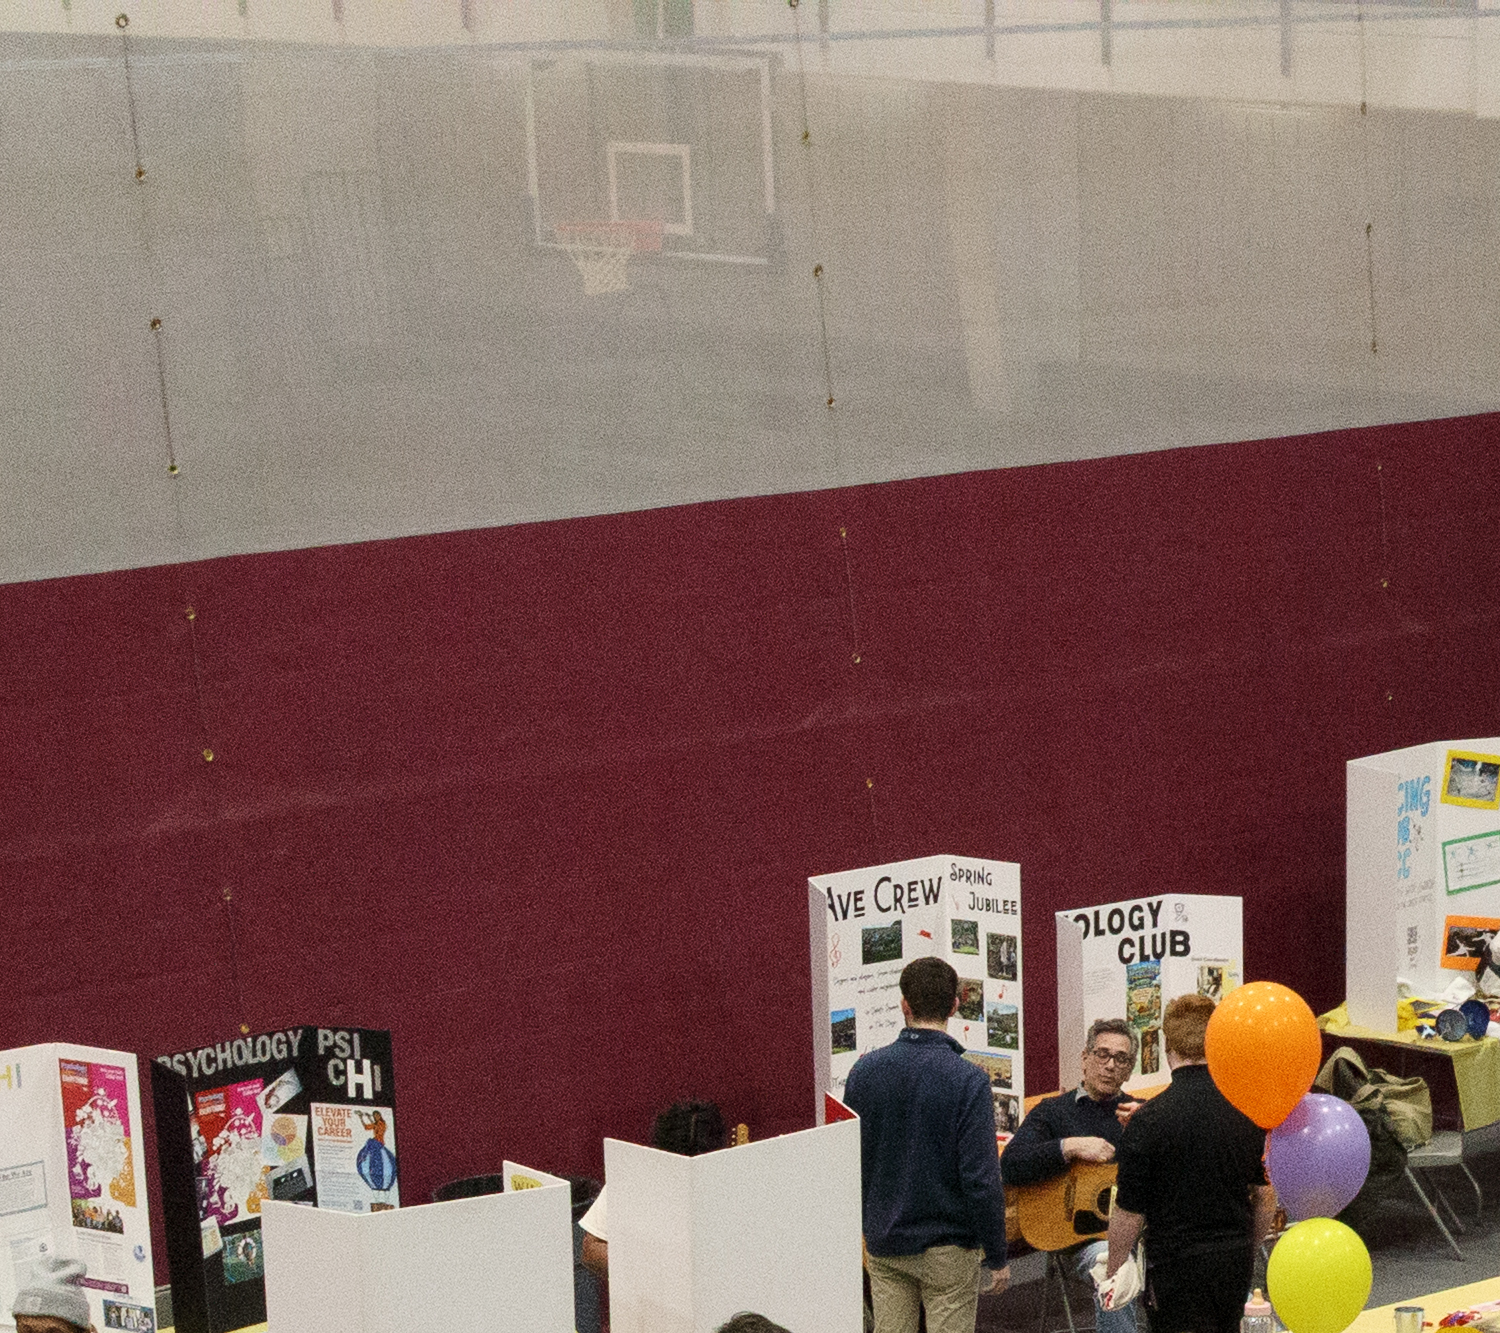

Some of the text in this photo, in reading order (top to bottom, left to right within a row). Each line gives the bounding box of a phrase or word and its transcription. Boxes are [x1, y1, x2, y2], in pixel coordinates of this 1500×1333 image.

[950, 863, 993, 886] SPRING
[873, 876, 943, 914] CREW
[968, 891, 1018, 916] JUBILEE
[1118, 929, 1191, 965] CLUB
[317, 1028, 361, 1060] PSI
[327, 1058, 382, 1100] CHI
[315, 1106, 352, 1118] ELEVATE
[317, 1126, 352, 1138] CAREER
